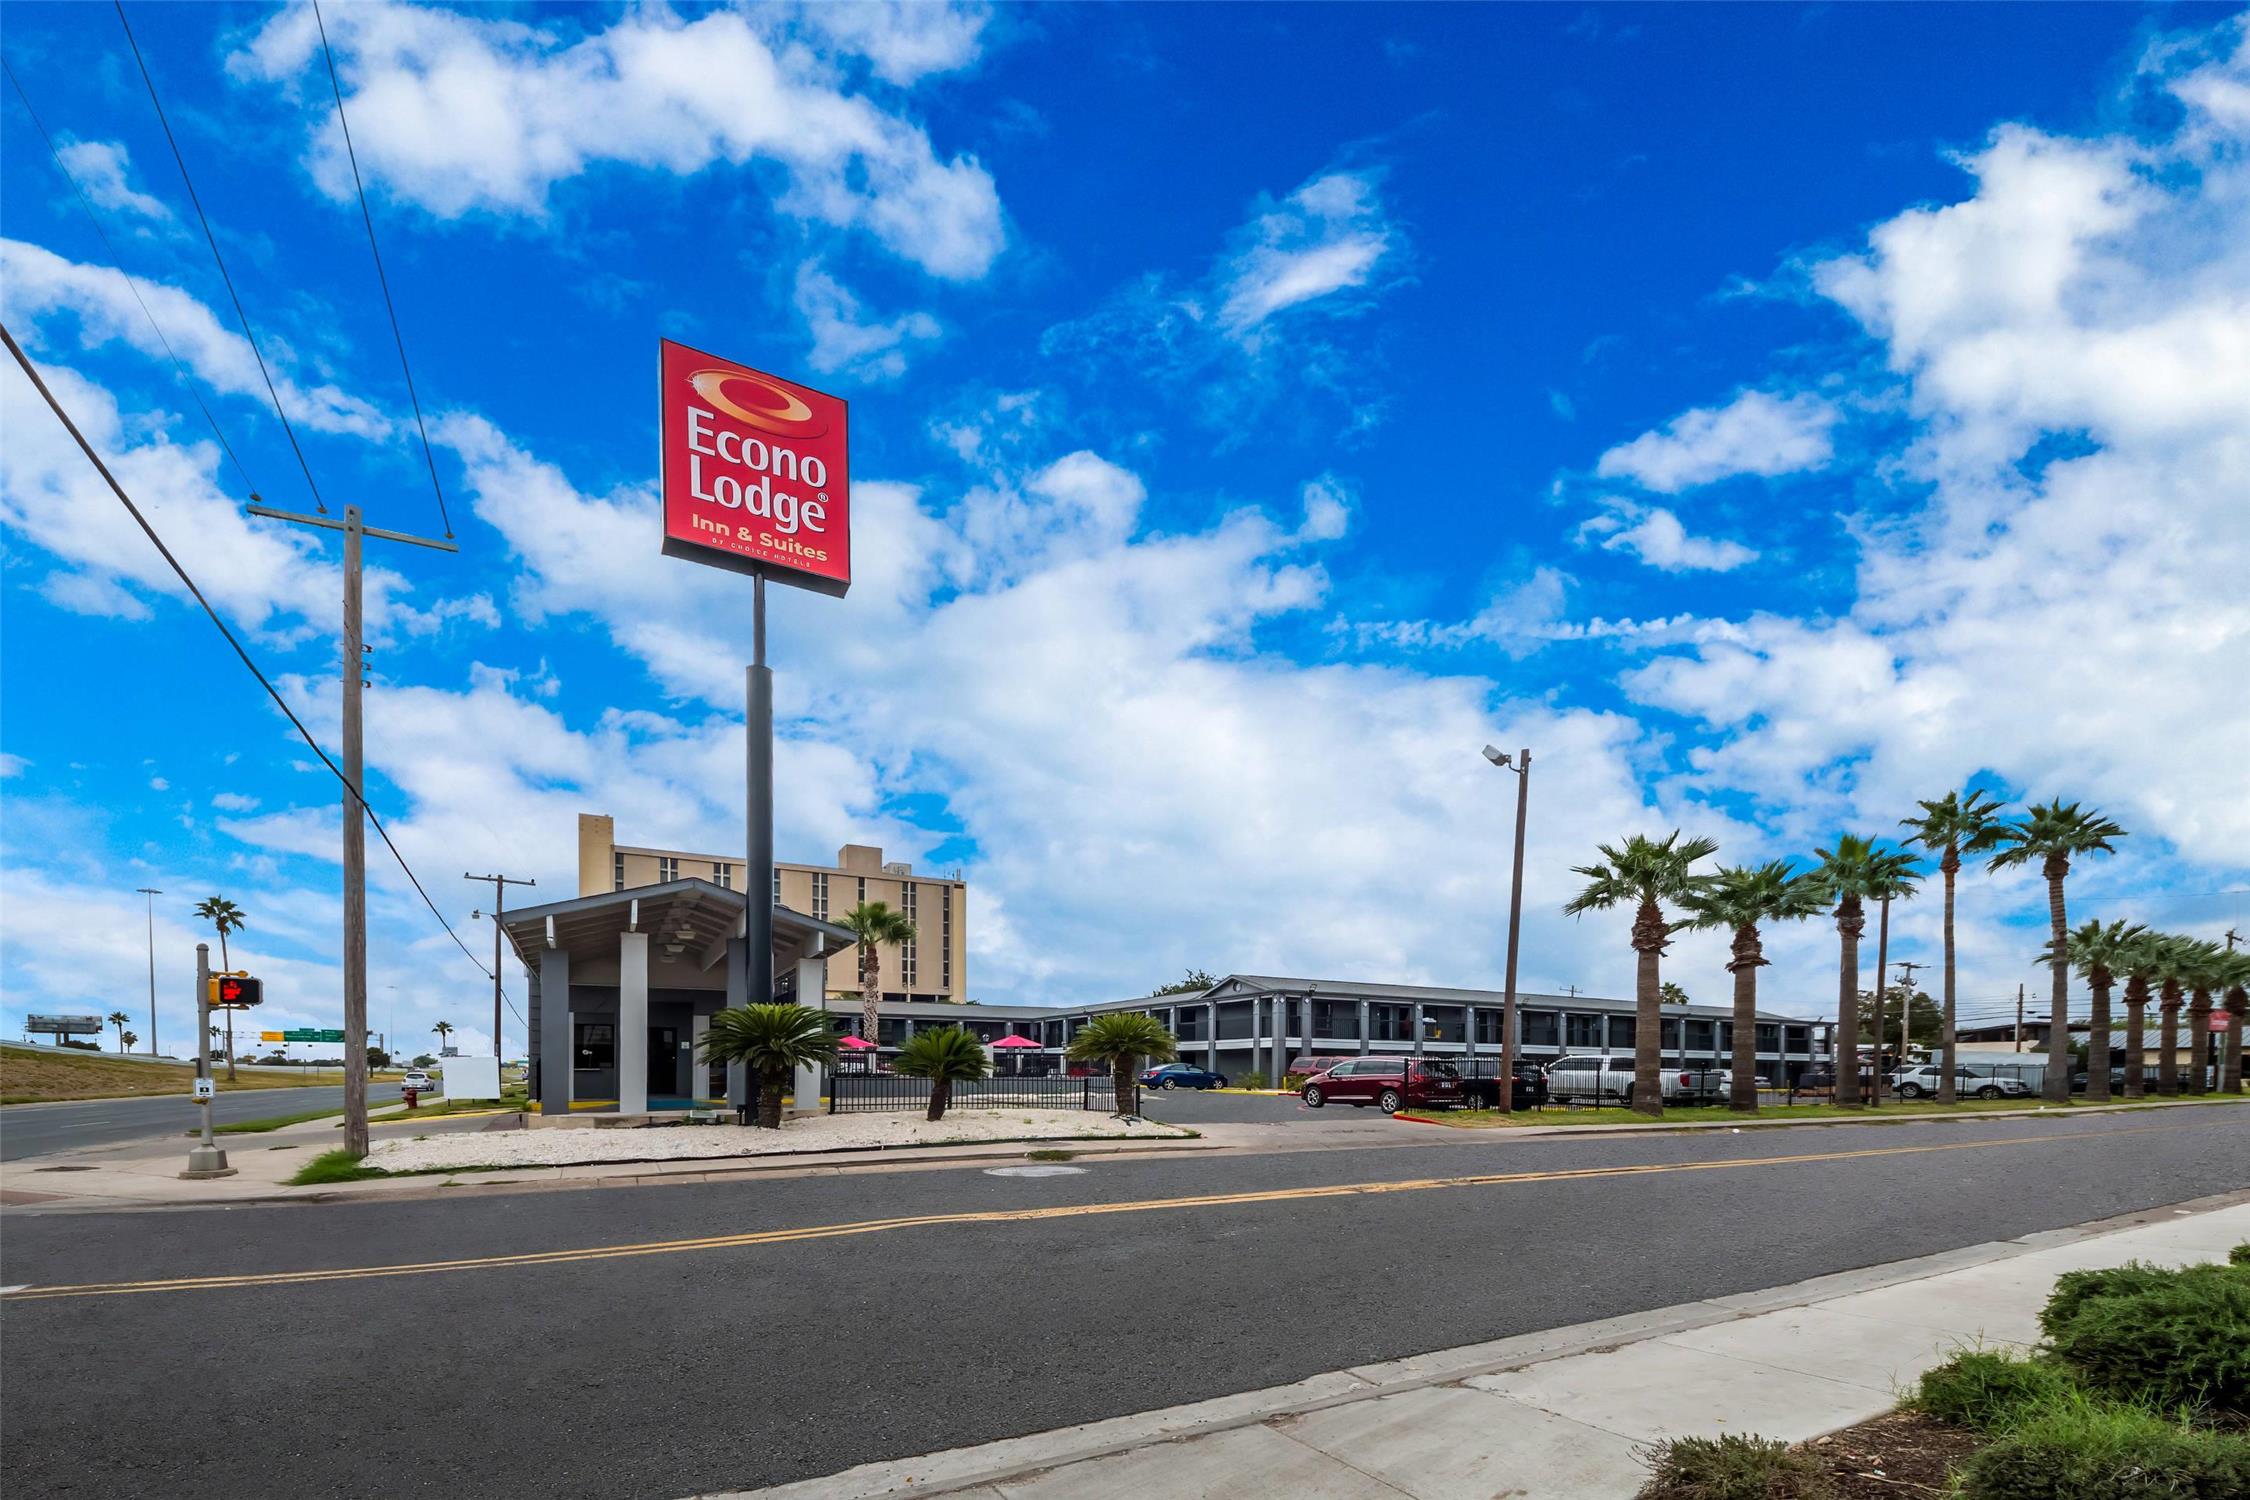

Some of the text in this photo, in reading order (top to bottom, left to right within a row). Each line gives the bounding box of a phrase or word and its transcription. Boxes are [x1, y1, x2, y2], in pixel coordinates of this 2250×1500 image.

[687, 405, 827, 488] Econo
[692, 513, 828, 561] Inn & Suites
[731, 542, 768, 556] CHOICE
[774, 553, 811, 568] HOTELS
